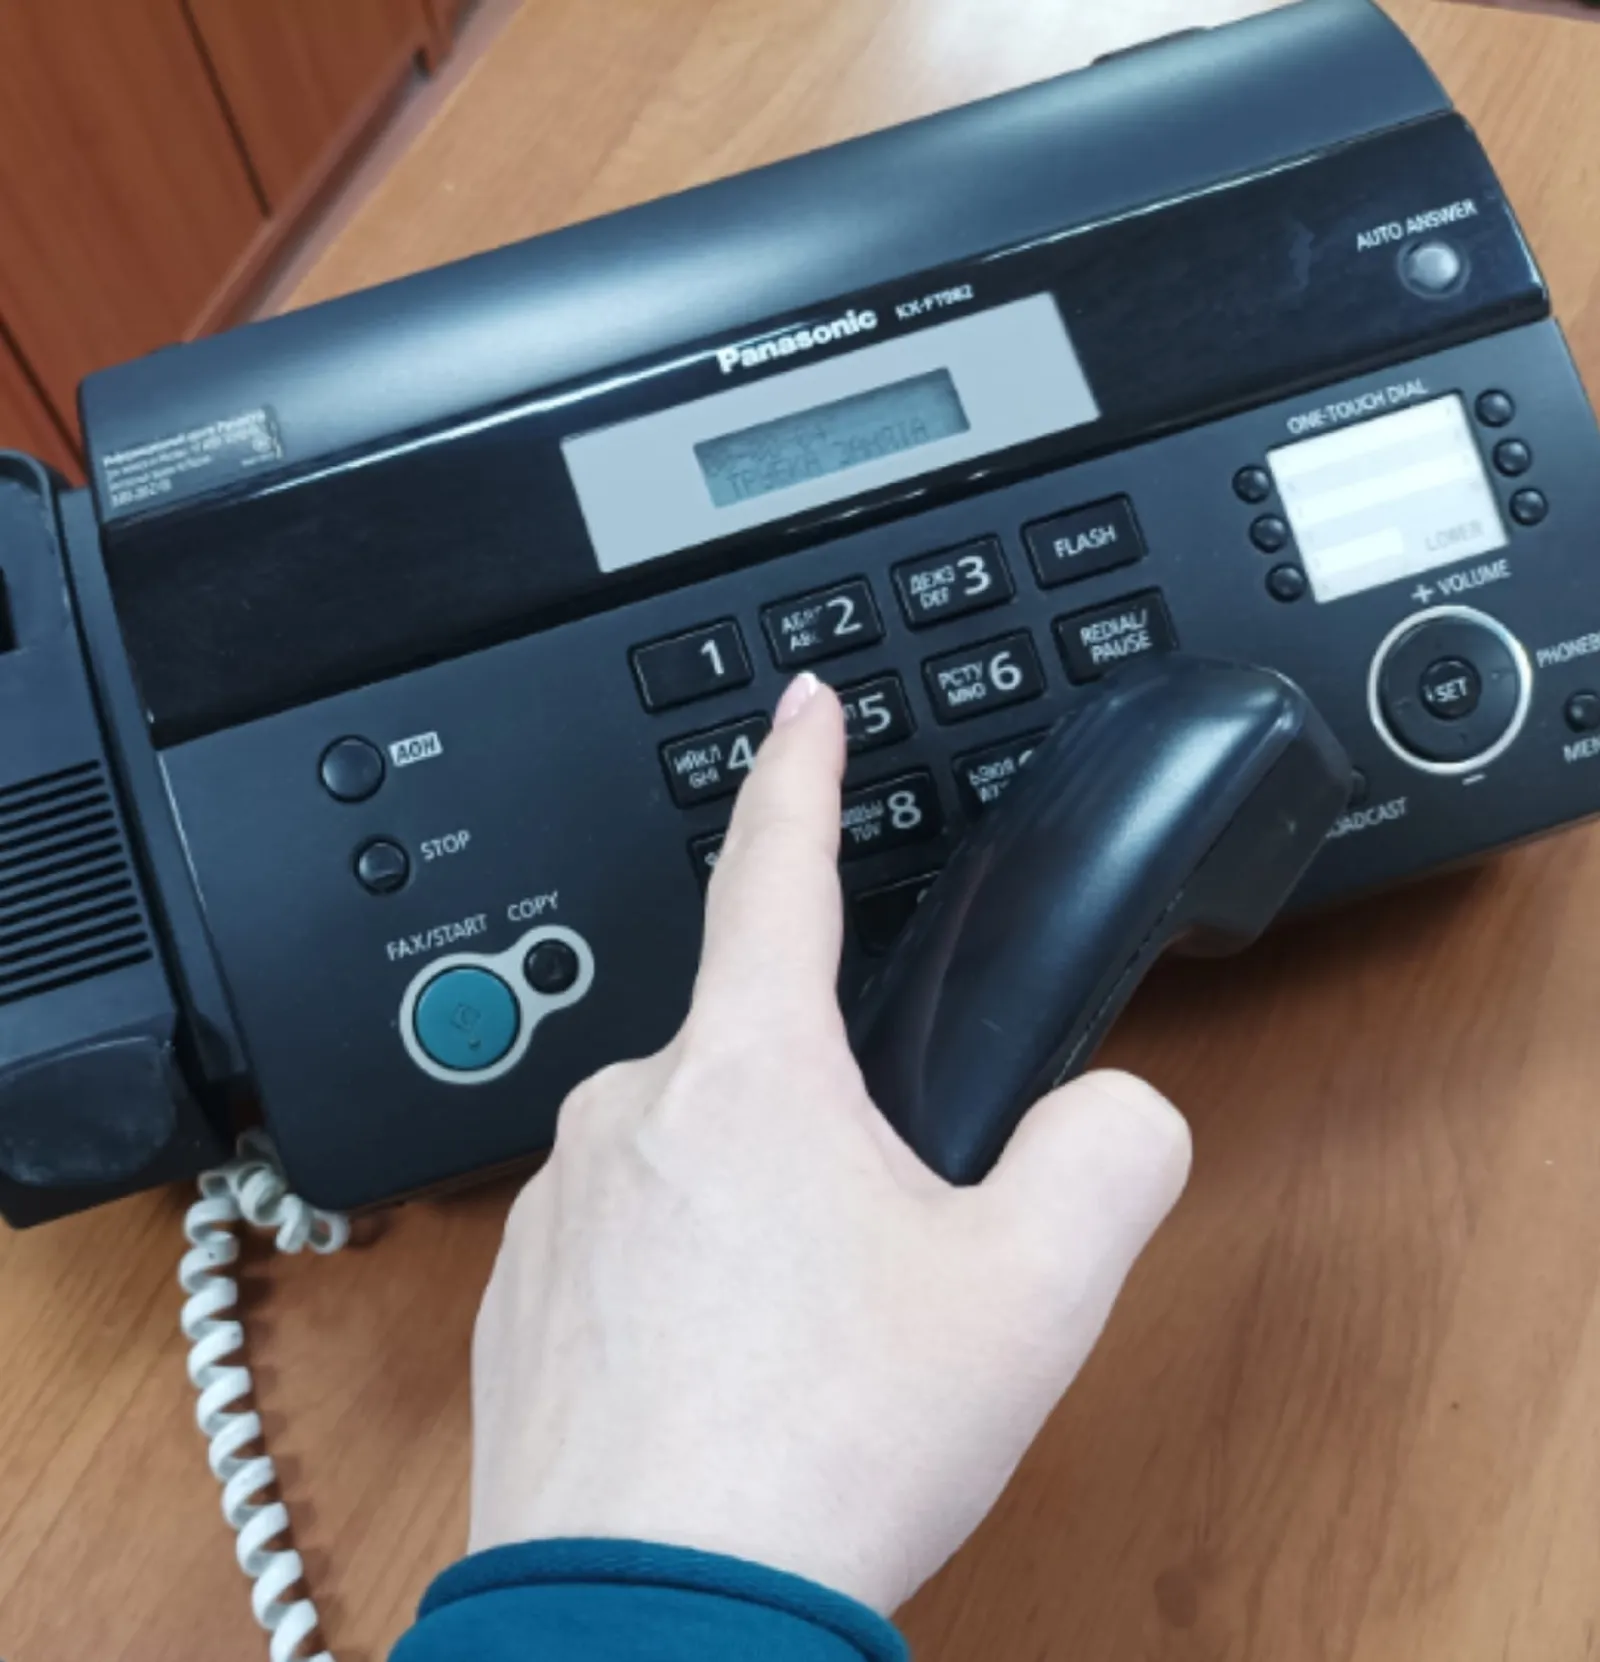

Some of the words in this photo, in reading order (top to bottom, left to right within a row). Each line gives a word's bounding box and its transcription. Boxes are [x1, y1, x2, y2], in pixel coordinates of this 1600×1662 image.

[1356, 222, 1402, 251] AUTO
[1406, 199, 1478, 235] ANSWER
[715, 309, 878, 374] Panasonic
[1286, 391, 1383, 434] ONE-TOUCH
[1387, 378, 1428, 406] DIAL
[1053, 525, 1117, 559] FLASH
[957, 555, 991, 595] 3
[1436, 559, 1512, 596] VOLUME
[826, 596, 862, 635] 2
[920, 587, 950, 610] DEF
[1080, 609, 1147, 646] REDIAL/
[701, 639, 724, 676] 1
[1091, 631, 1152, 665] PAUSE
[1536, 631, 1600, 668] PHONEB
[989, 651, 1022, 691] 6
[1435, 677, 1467, 702] SET
[858, 692, 892, 734] 5
[948, 682, 987, 707] MNO
[726, 735, 755, 770] 4
[1563, 733, 1600, 764] MEN
[887, 790, 922, 829] 8
[420, 830, 471, 861] STOP
[851, 821, 881, 843] TUV
[507, 890, 559, 921] COPY
[386, 913, 488, 961] FAX/START
